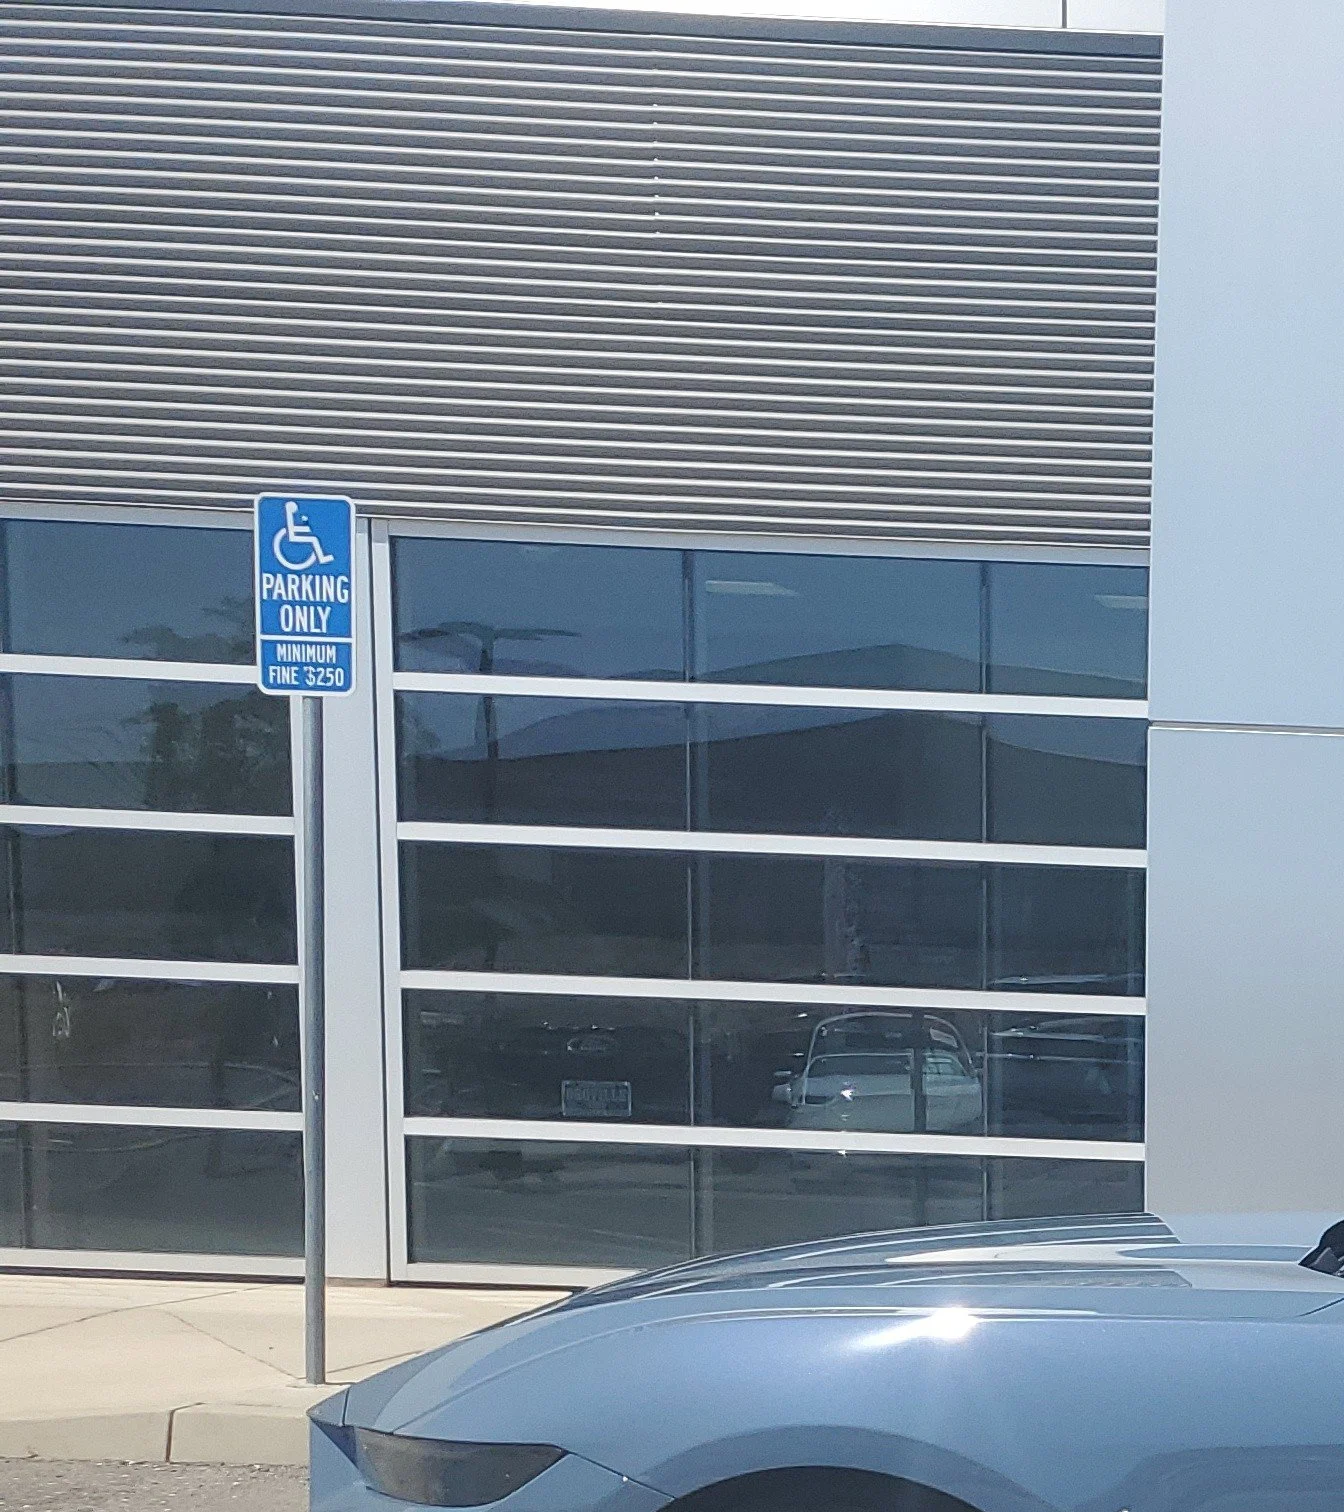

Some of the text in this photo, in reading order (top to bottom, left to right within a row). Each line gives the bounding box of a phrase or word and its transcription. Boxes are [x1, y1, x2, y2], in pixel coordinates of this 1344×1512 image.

[262, 573, 349, 603] PARKING
[280, 605, 331, 633] ONLY
[276, 644, 336, 664] MINIMUM
[268, 666, 344, 687] FINE $250
